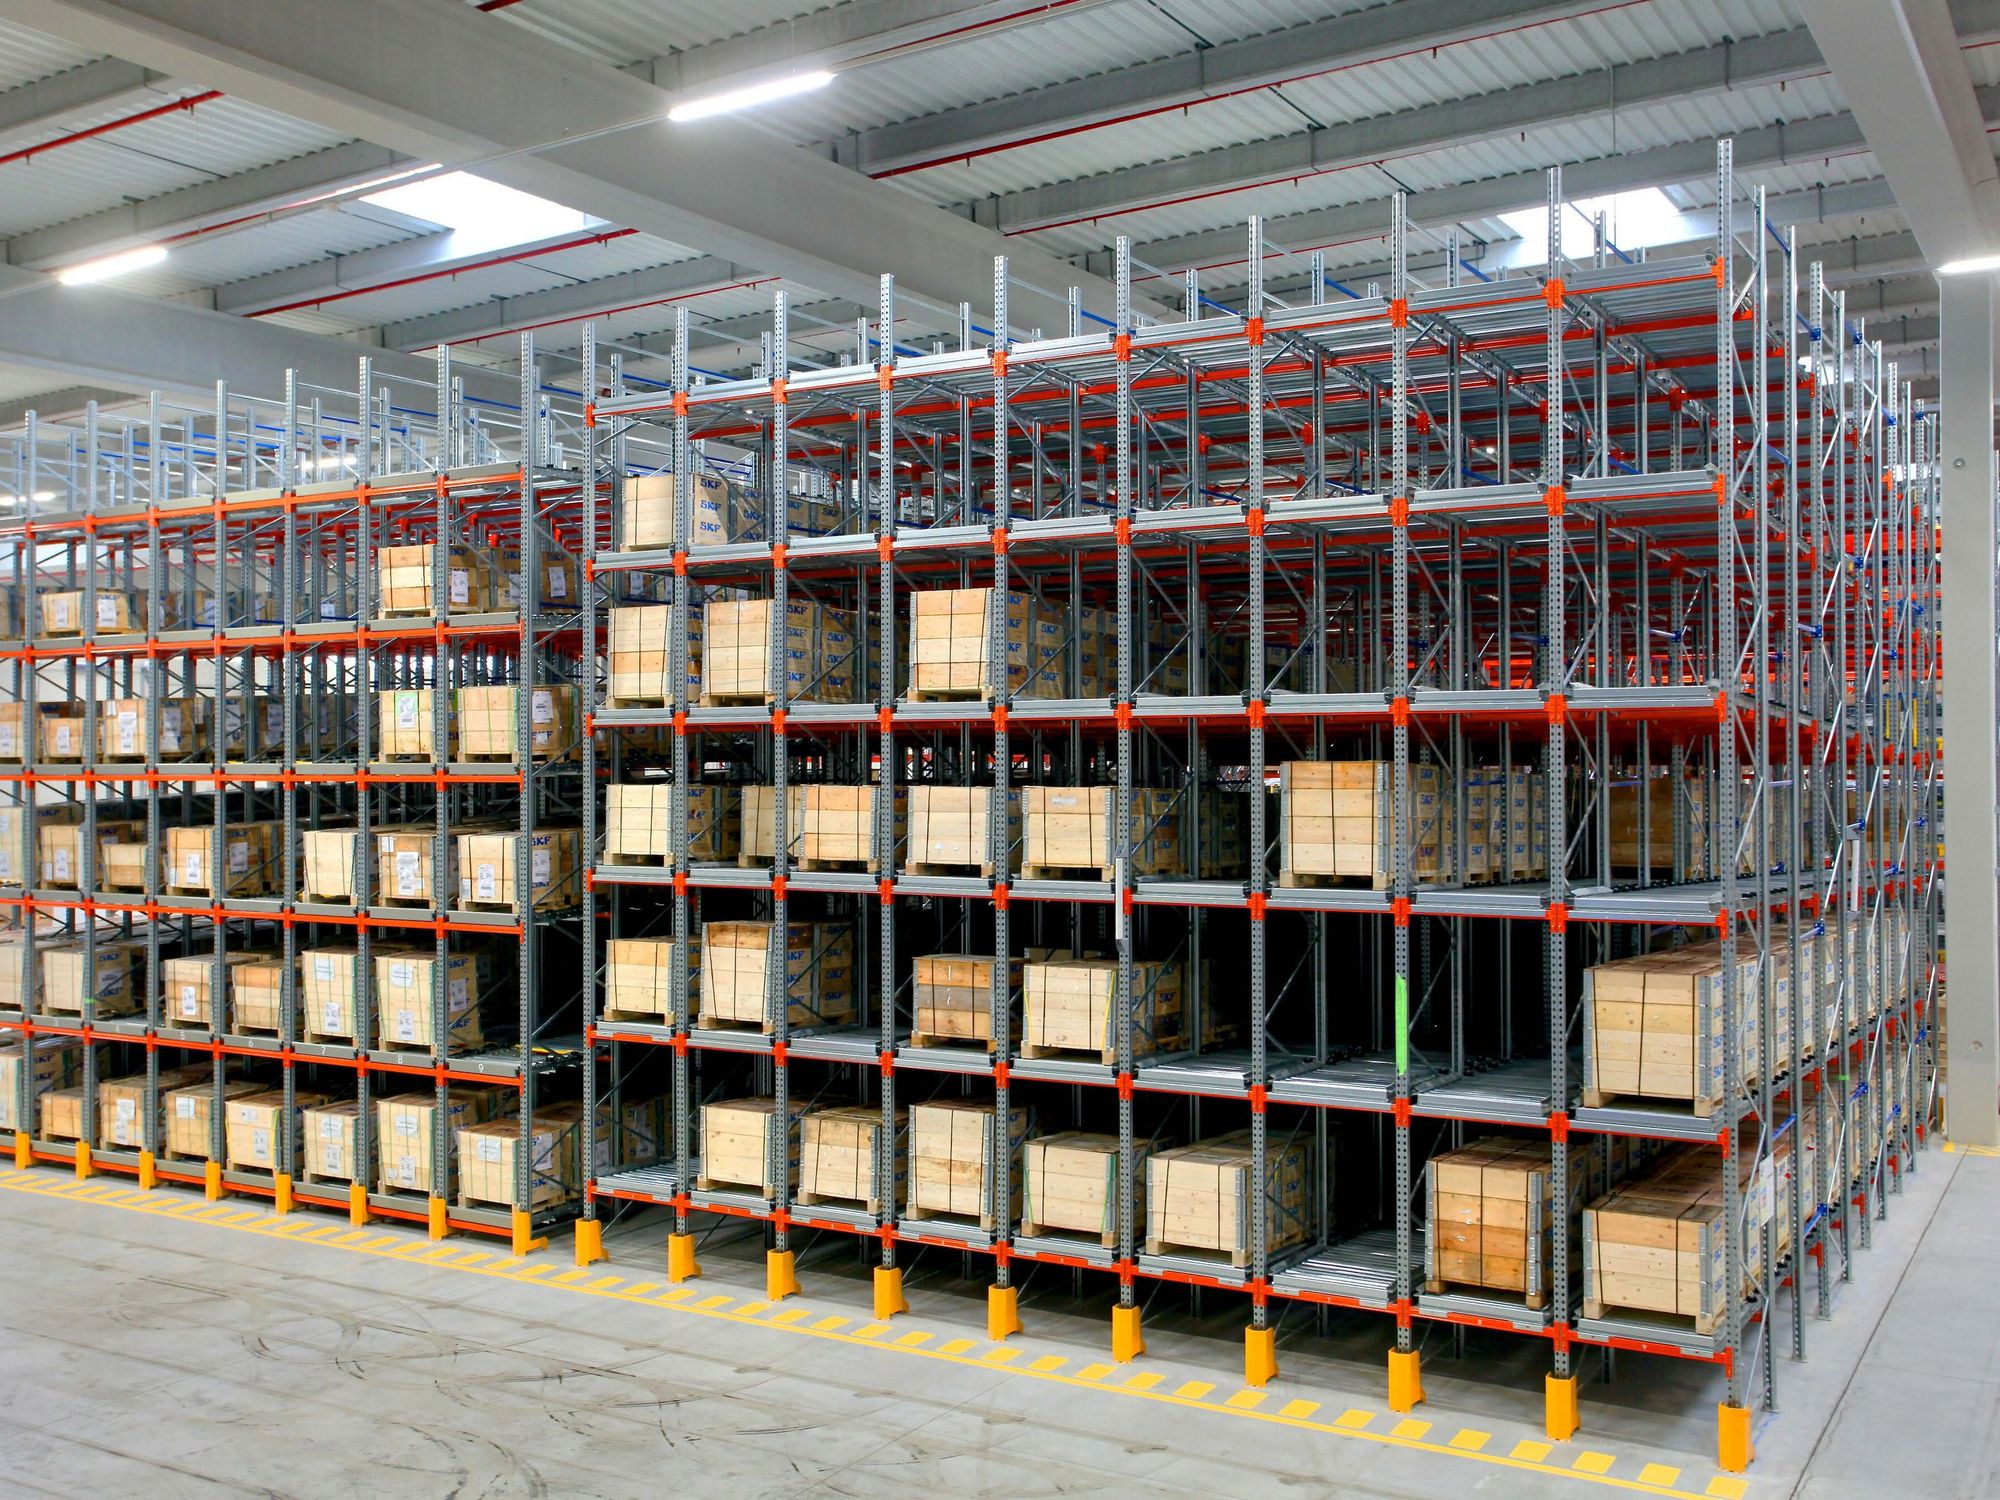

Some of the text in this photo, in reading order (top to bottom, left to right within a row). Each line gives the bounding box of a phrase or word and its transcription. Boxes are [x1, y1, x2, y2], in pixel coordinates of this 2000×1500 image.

[701, 478, 722, 490] SKF
[701, 500, 721, 512] SKF
[700, 522, 721, 532] SKF
[1008, 595, 1023, 605] KF
[787, 606, 807, 614] SKF
[1008, 618, 1022, 628] KF
[787, 628, 806, 637] SKF
[1041, 624, 1058, 634] SKF
[827, 632, 847, 642] SKF
[1008, 641, 1021, 652] KF
[787, 650, 806, 659] SKF
[1008, 666, 1020, 674] KF
[786, 672, 806, 681] SKF
[827, 675, 846, 686] SKF
[1041, 670, 1059, 682] SKF
[532, 731, 553, 740] SF
[826, 969, 846, 979] SKF
[449, 1018, 470, 1028] KF
[181, 1031, 185, 1040] 5
[248, 1039, 254, 1047] 6
[321, 1047, 326, 1055] 7
[398, 1055, 403, 1064] 8
[478, 1064, 484, 1073] 9
[1009, 1112, 1021, 1122] KF
